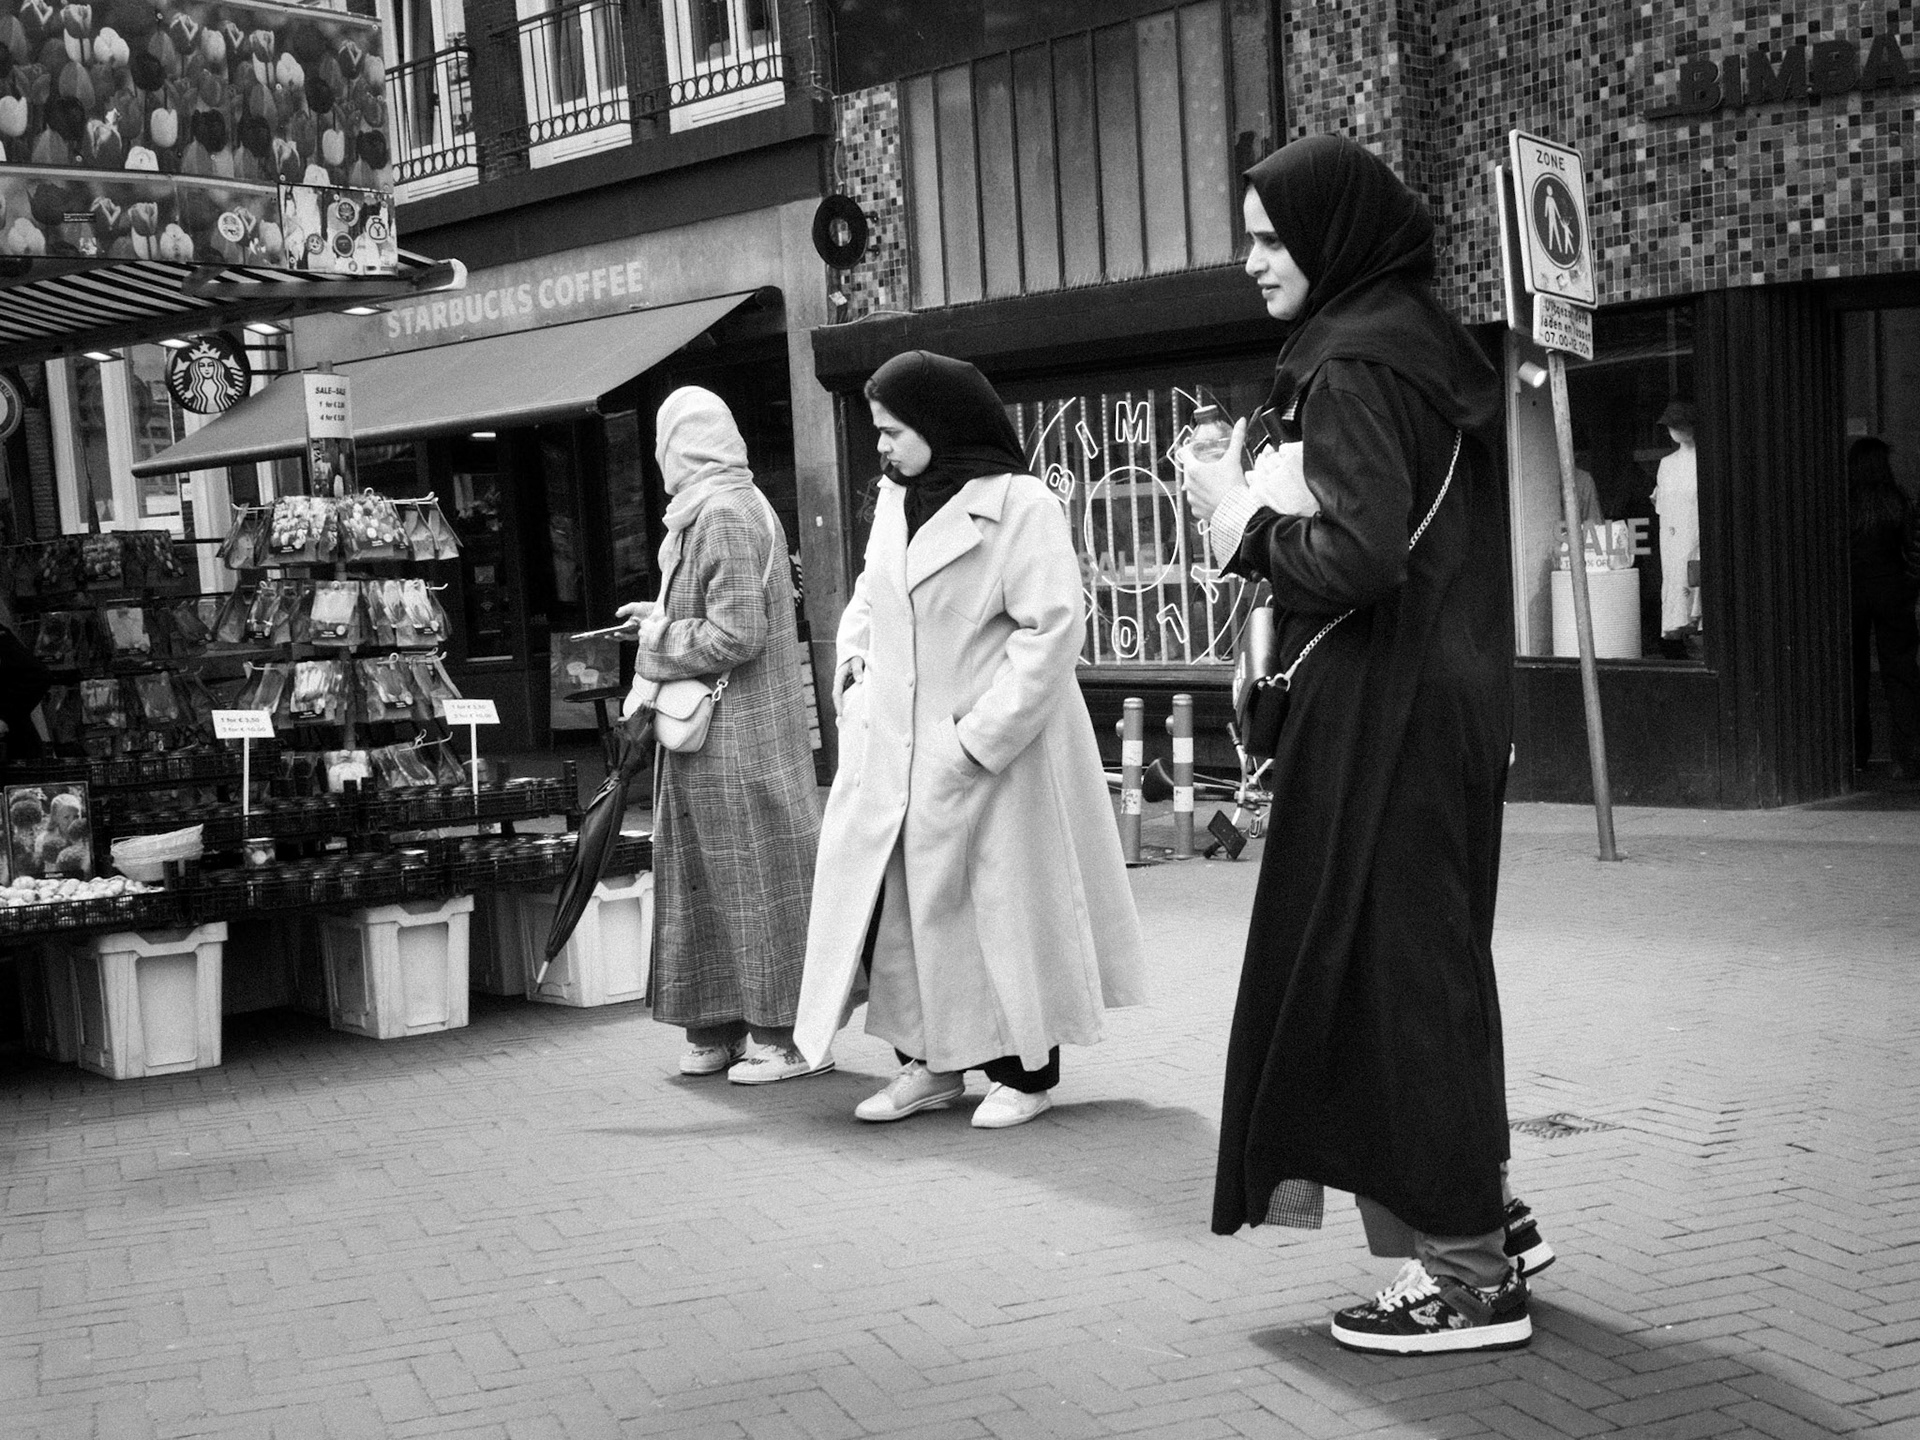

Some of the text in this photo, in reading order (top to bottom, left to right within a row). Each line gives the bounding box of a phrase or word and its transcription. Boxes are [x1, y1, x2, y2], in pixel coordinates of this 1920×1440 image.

[1680, 33, 1910, 110] BIMBA
[1536, 149, 1566, 171] ZONE
[385, 261, 645, 338] STARBUCKS COFFEE
